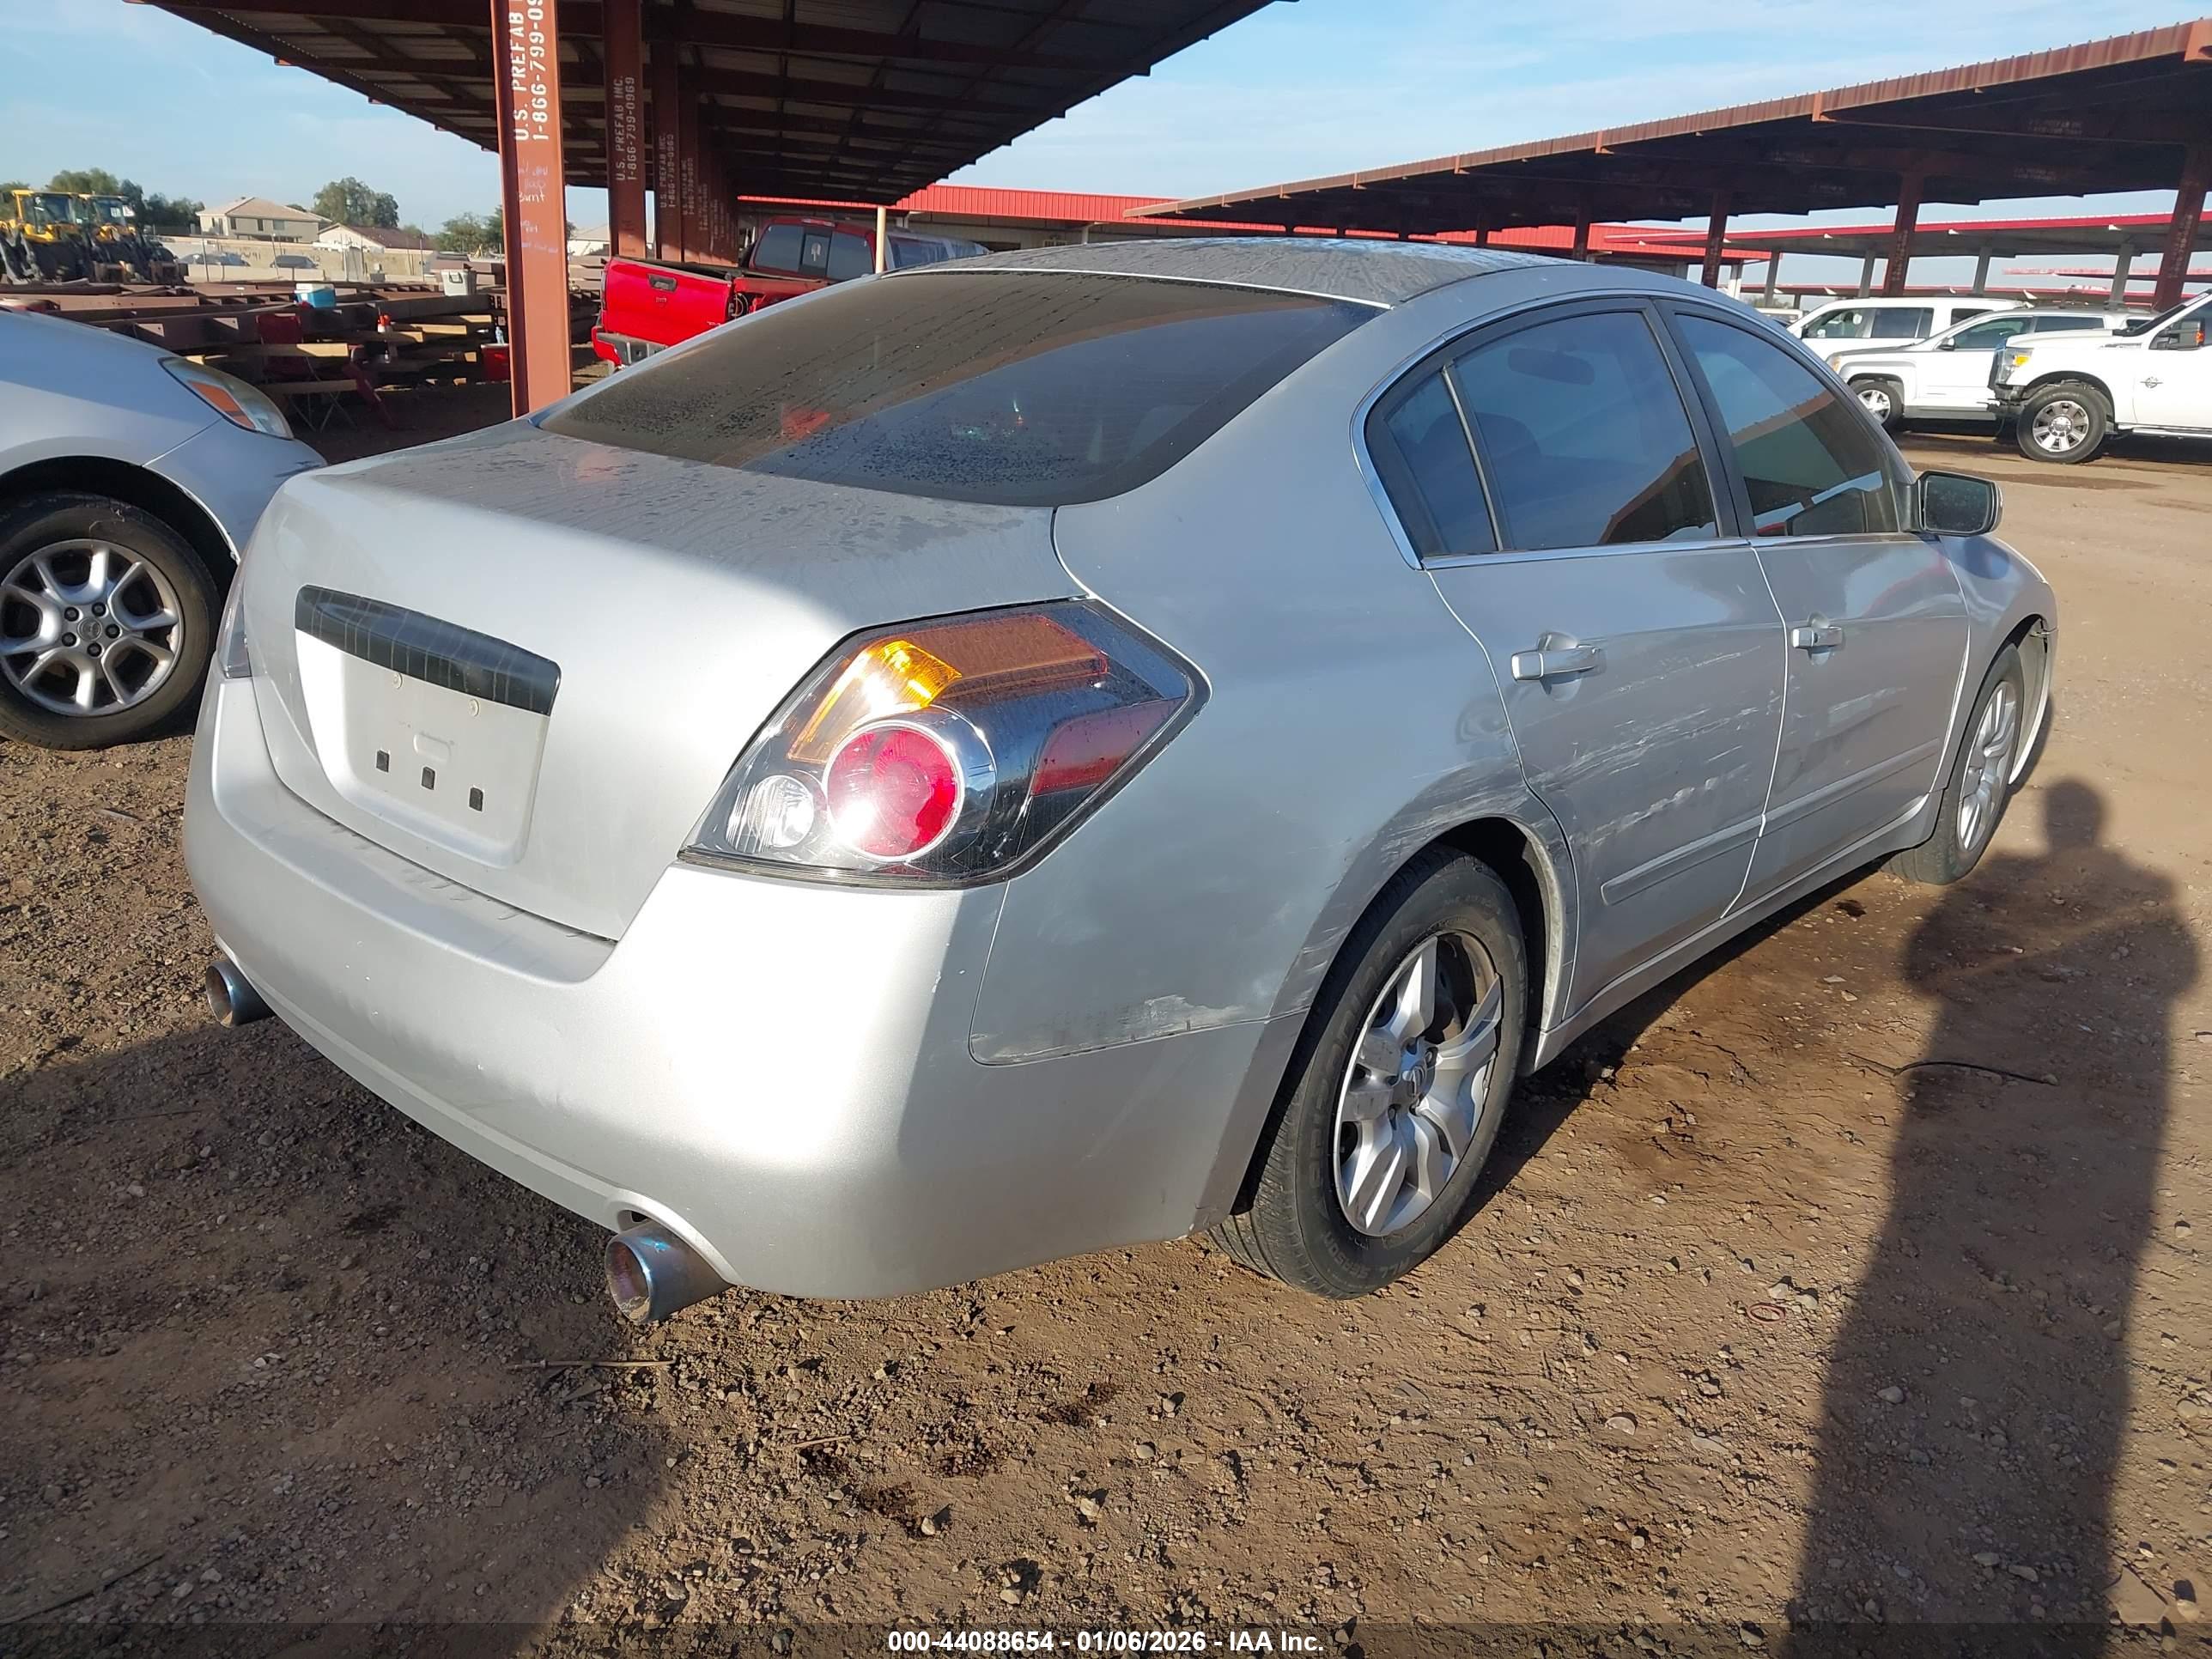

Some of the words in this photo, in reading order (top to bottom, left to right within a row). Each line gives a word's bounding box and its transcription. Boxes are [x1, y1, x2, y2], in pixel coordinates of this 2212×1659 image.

[508, 12, 526, 92] PREFAB
[613, 76, 623, 98] INC.
[513, 104, 529, 141] U.S.
[614, 104, 625, 152] PREFAB
[625, 76, 637, 180] 1-866-799-0969
[616, 158, 626, 180] U.S.
